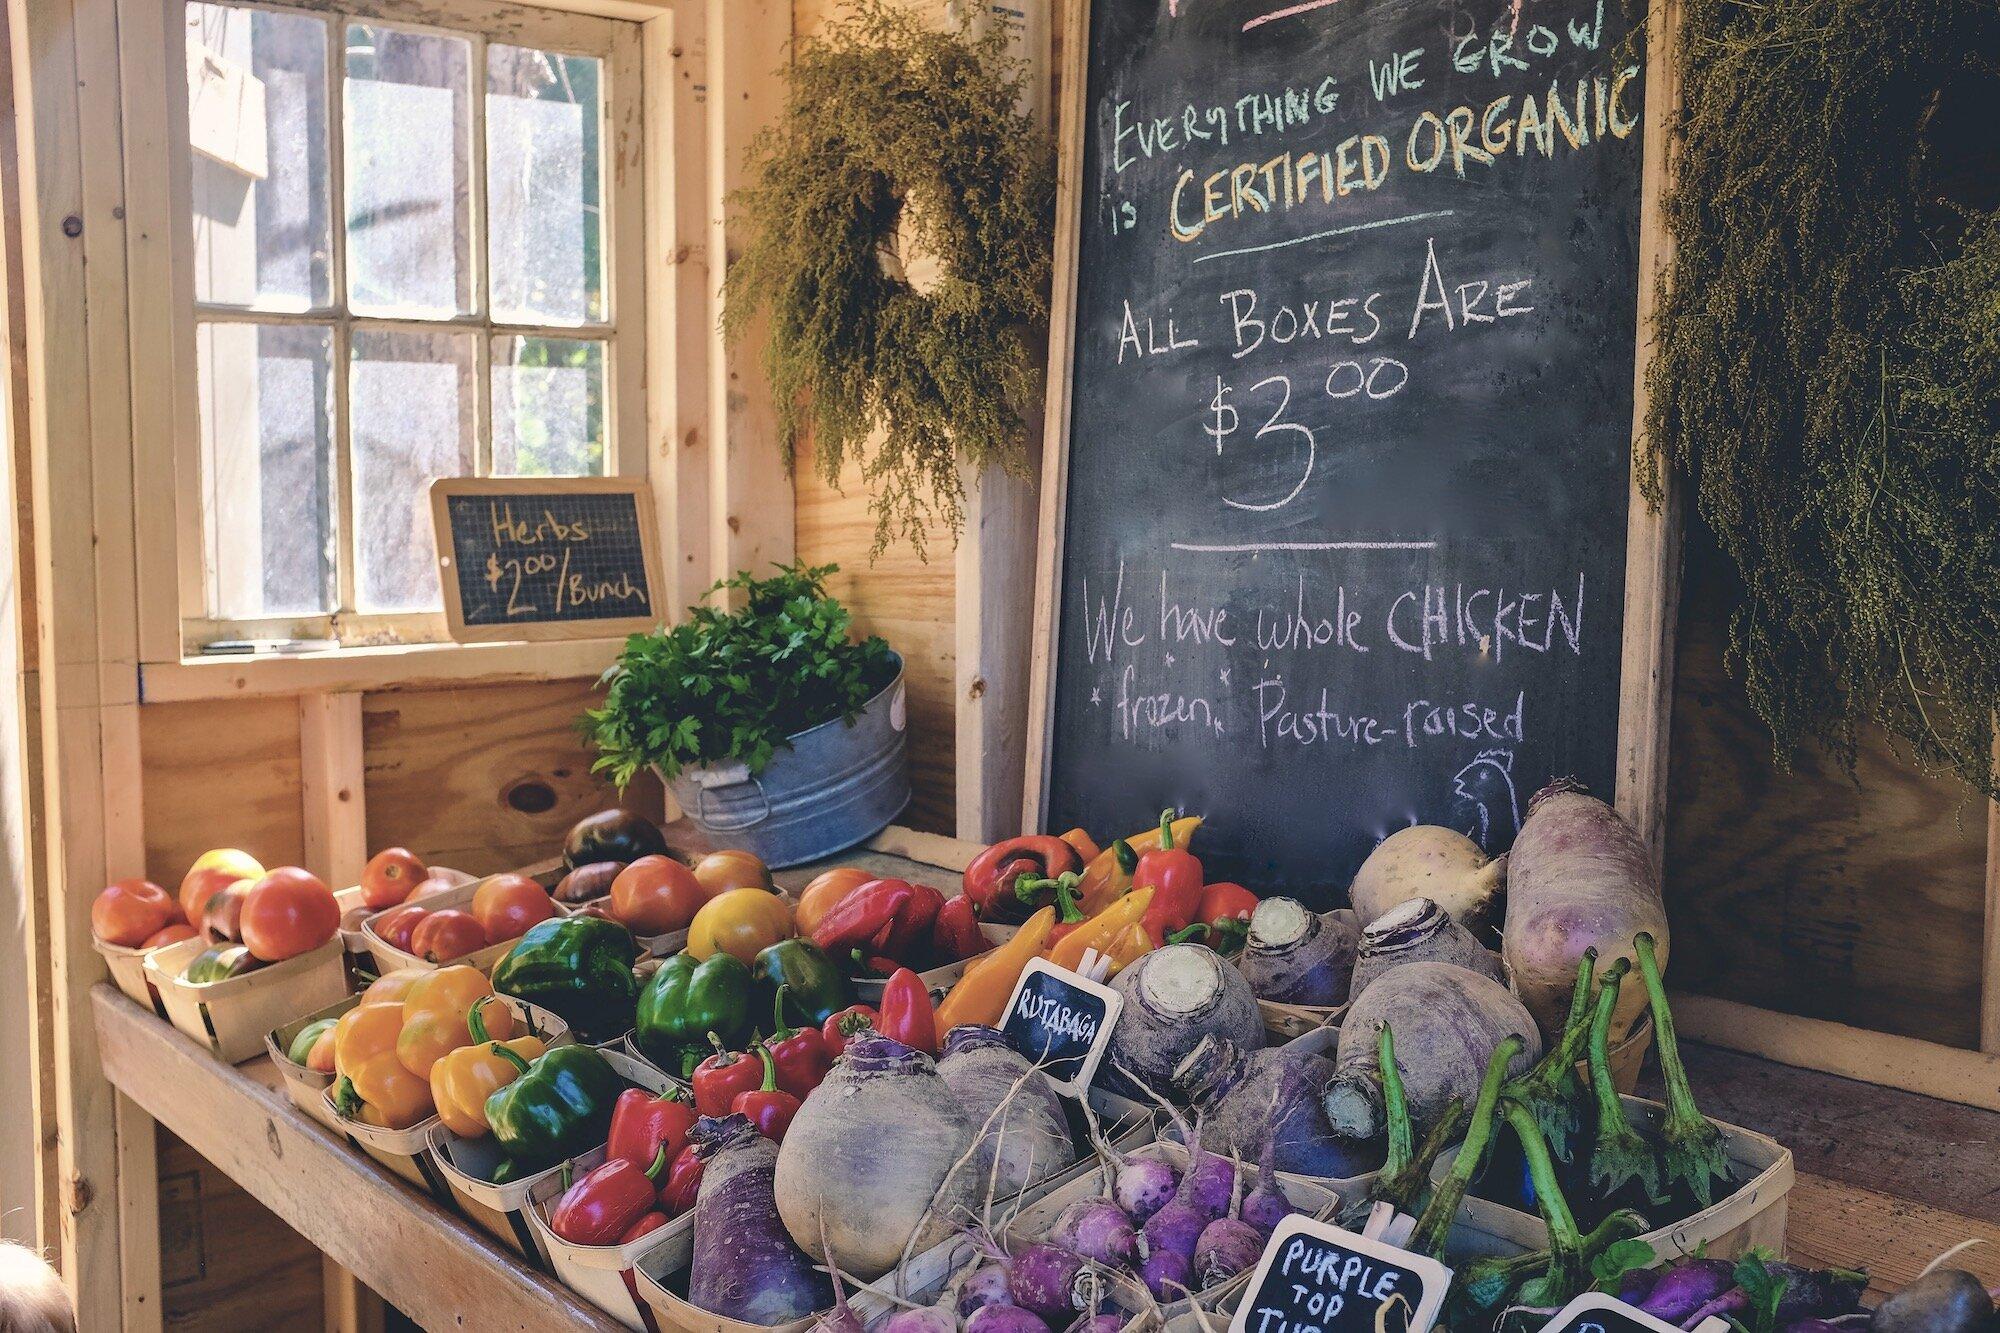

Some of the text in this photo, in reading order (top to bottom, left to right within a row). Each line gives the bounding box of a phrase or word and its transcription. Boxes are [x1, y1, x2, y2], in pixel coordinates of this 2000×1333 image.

[1114, 0, 1604, 174] EVERYTHING WE GROW
[1170, 134, 1390, 242] CERTIFIED
[1406, 65, 1641, 180] ORGANIC
[1117, 237, 1535, 365] ALL BOXES ARE
[490, 501, 589, 547] Herbs
[1083, 560, 1585, 665] We have whole CHICKEN
[1252, 674, 1524, 748] Pasture-raised
[1017, 988, 1096, 1044] RUTABAGA
[1281, 1238, 1400, 1301] PURPLE
[1291, 1284, 1344, 1324] TOP
